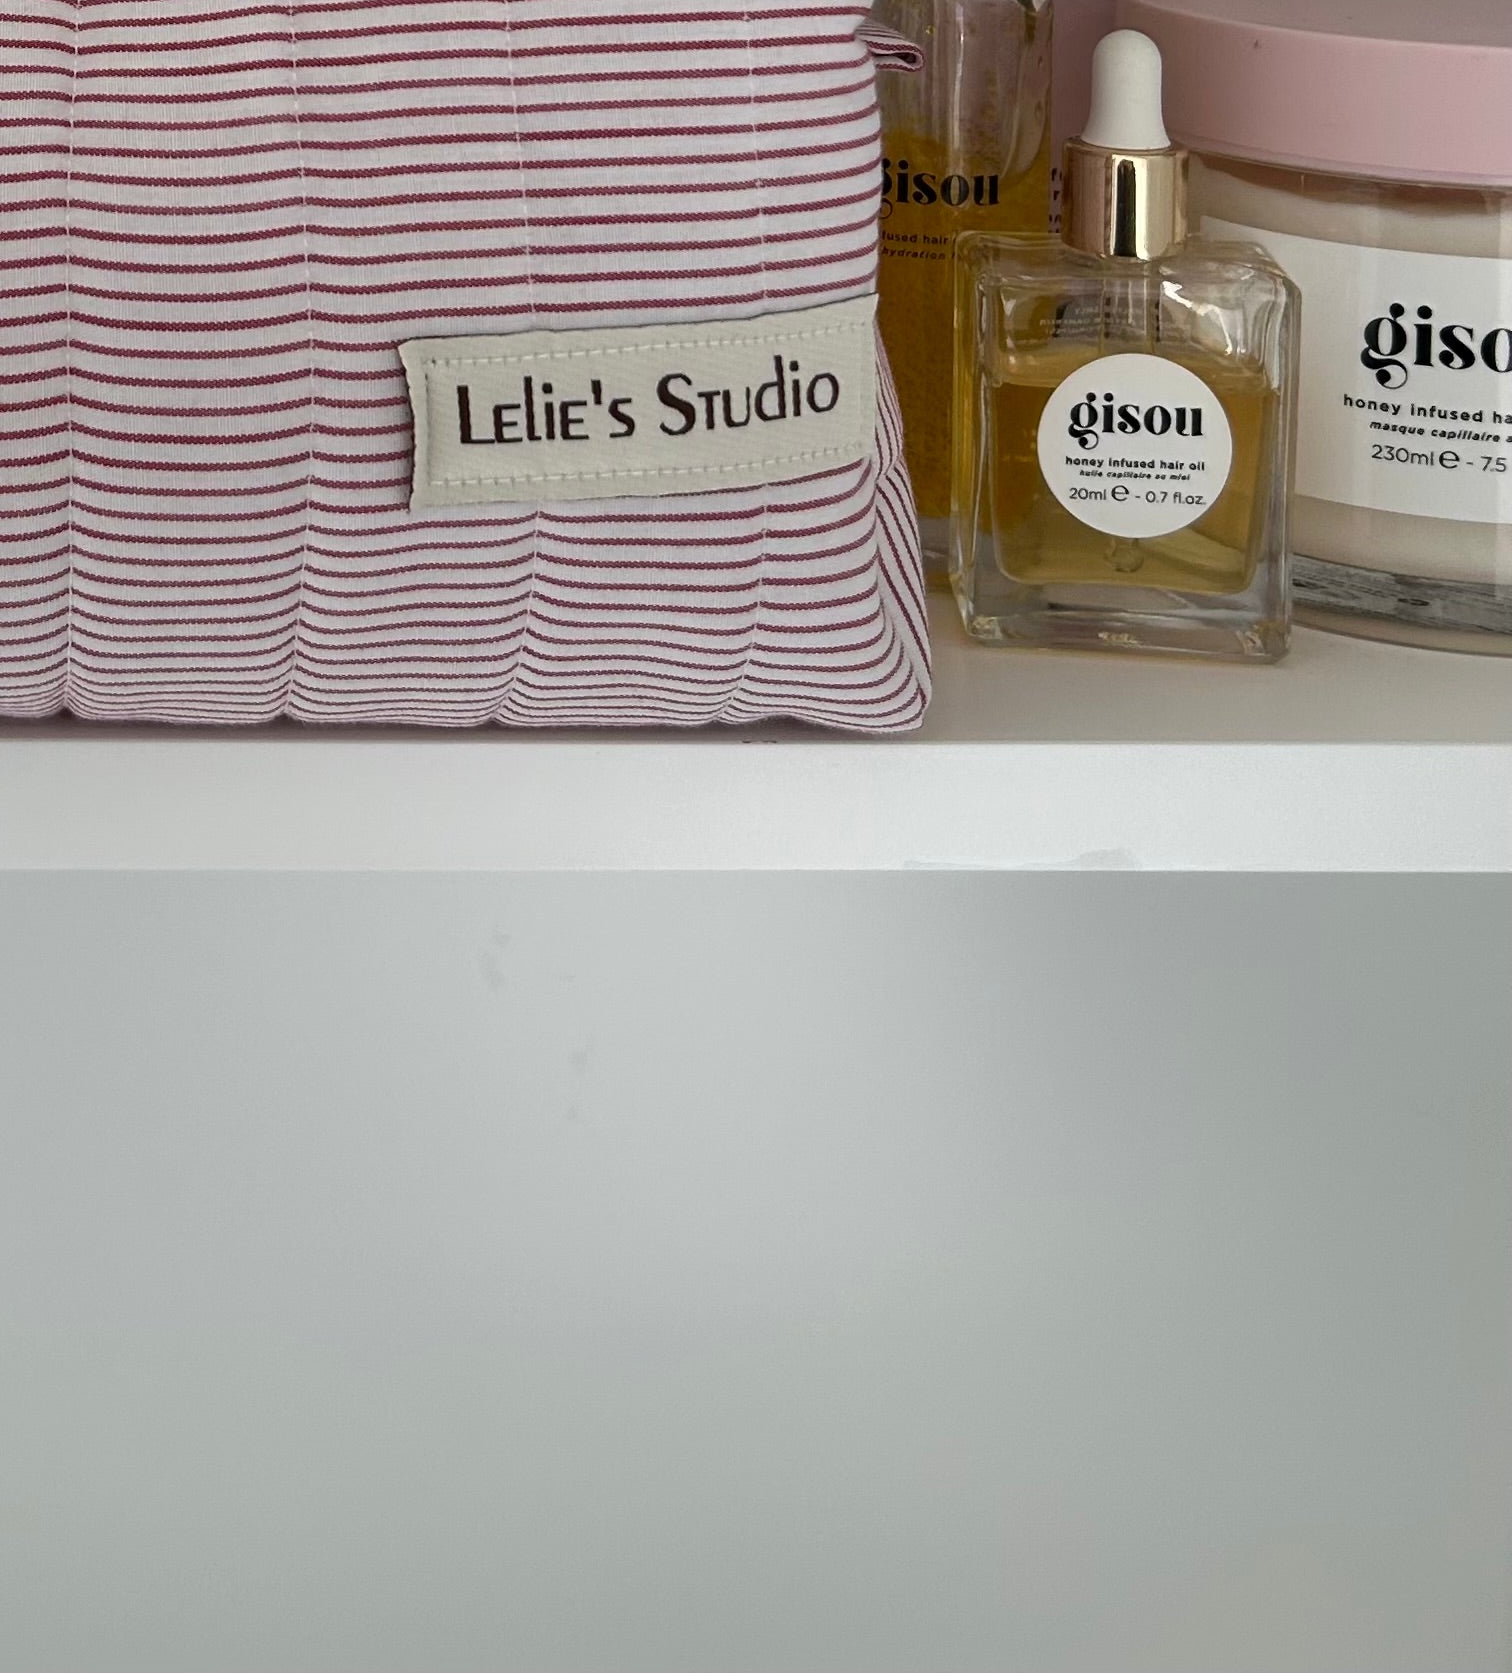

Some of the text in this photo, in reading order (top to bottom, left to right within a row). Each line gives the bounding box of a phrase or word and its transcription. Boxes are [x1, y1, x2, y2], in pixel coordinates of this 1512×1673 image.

[882, 230, 918, 244] fused
[923, 232, 949, 245] hair
[1360, 303, 1512, 390] giso
[1068, 392, 1203, 450] gisou
[1344, 394, 1512, 425] honey infused ha
[1369, 420, 1425, 435] masque
[1431, 428, 1500, 443] capillaire
[1065, 456, 1205, 471] honey infused hair oil
[1371, 444, 1434, 467] 230ml
[1069, 486, 1107, 501] 20ml
[1145, 491, 1168, 503] 0.7
